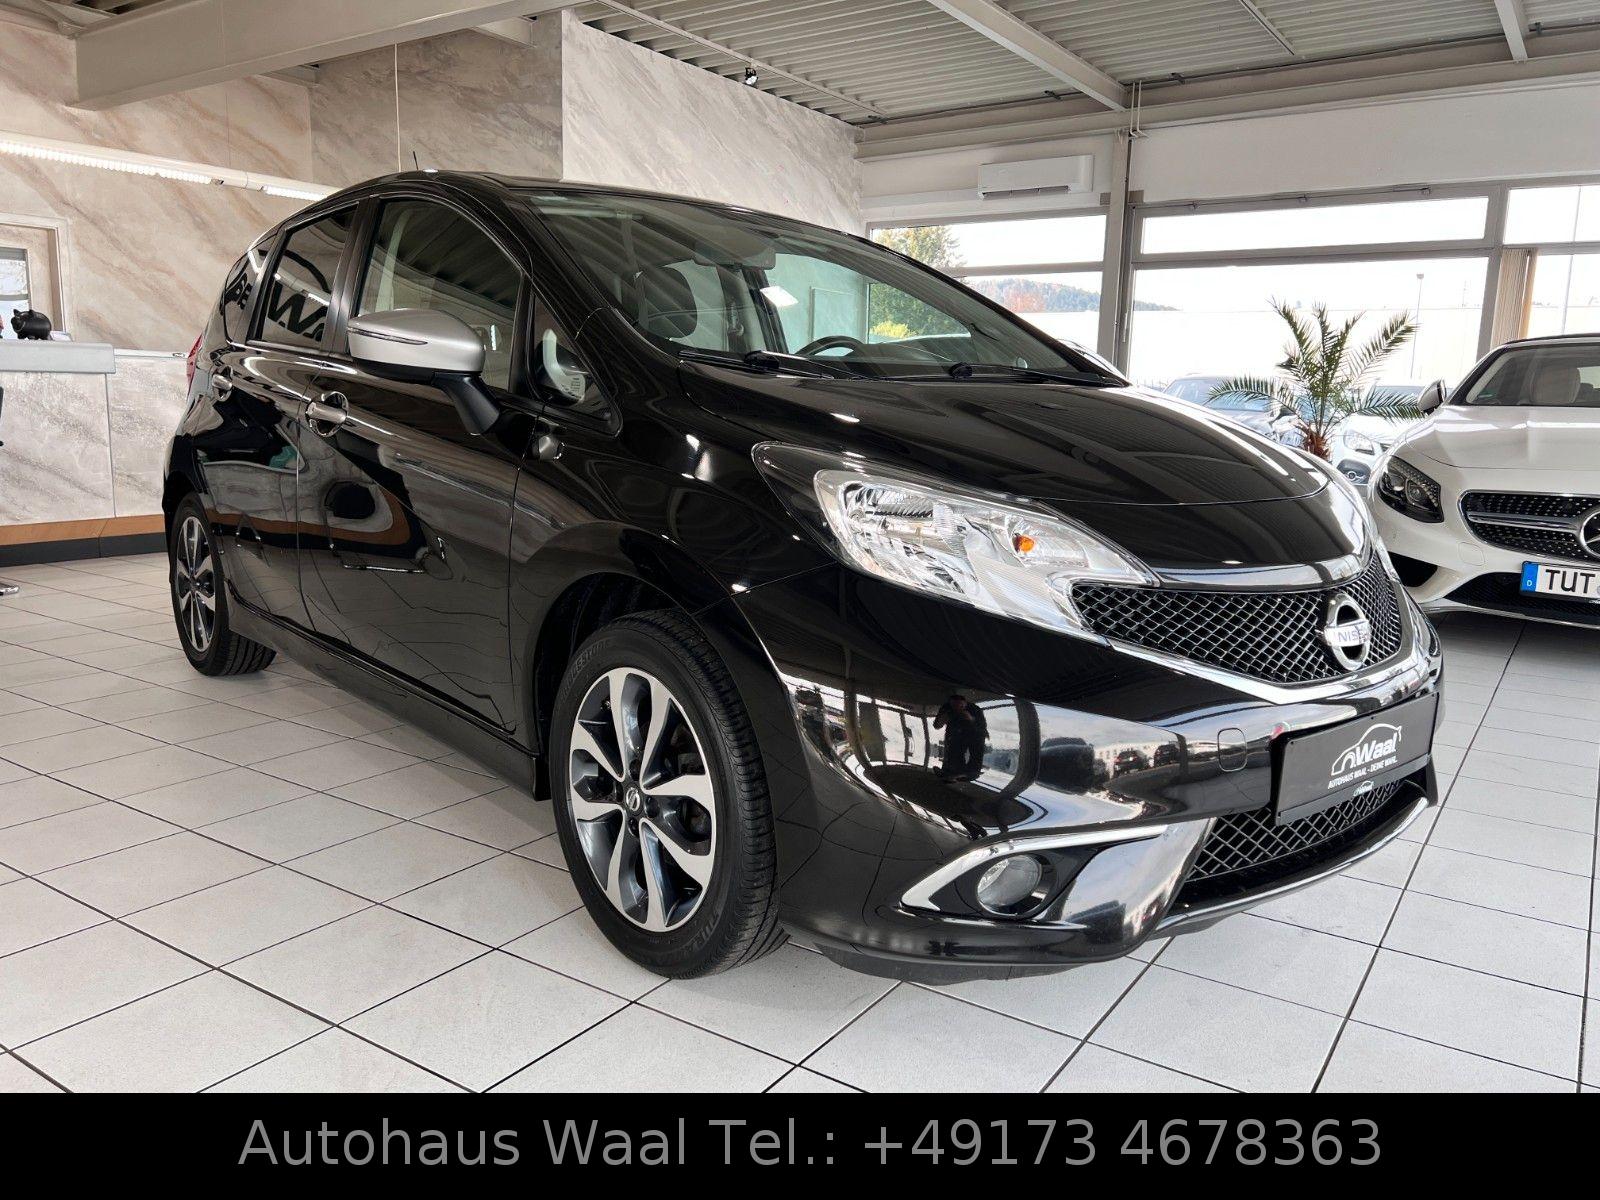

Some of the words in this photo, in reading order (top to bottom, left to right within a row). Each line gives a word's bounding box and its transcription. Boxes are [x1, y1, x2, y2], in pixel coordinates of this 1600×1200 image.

[1545, 568, 1596, 594] TUT
[1355, 732, 1398, 766] Waal
[1327, 772, 1354, 789] AUTOHAUS
